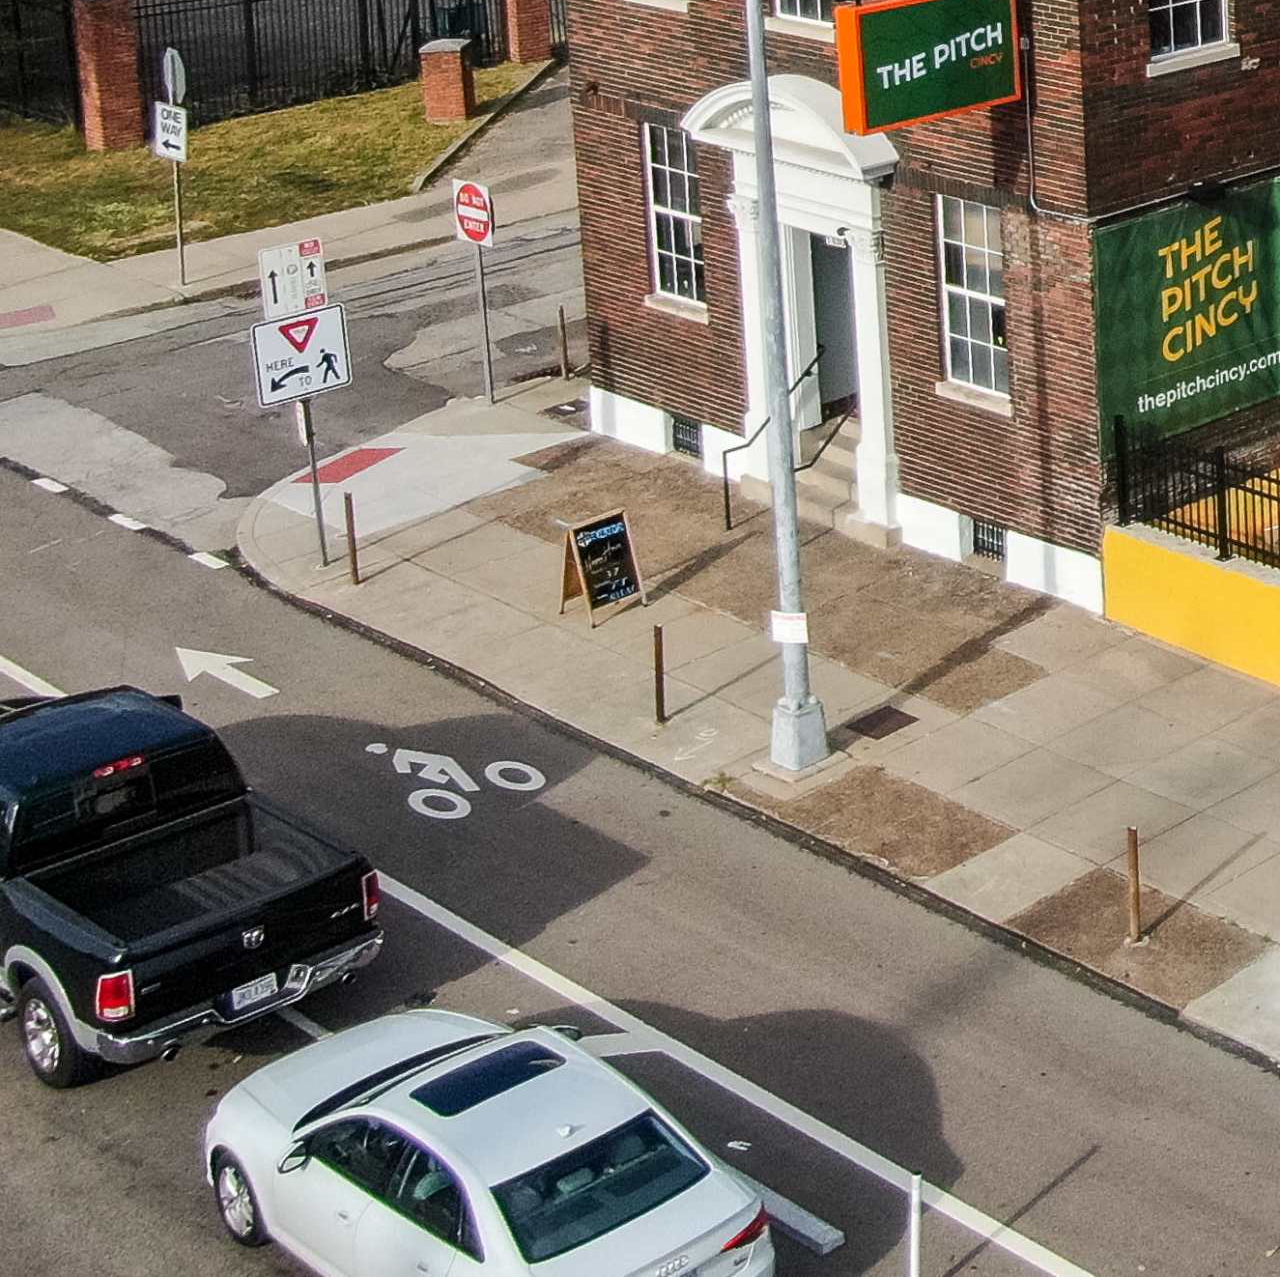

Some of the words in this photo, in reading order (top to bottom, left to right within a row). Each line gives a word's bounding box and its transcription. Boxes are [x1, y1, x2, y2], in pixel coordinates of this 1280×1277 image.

[876, 51, 927, 90] THE
[932, 21, 1003, 70] PITCH
[970, 52, 1004, 69] CINCY
[161, 108, 182, 124] ONE
[161, 122, 184, 137] WAY
[459, 192, 470, 204] DO
[472, 195, 485, 208] NOT
[463, 218, 485, 233] ENTER
[1158, 215, 1223, 279] THE
[1161, 240, 1253, 322] PITCH
[1162, 280, 1257, 362] CINCY
[266, 357, 294, 372] HERE
[299, 375, 312, 387] TO
